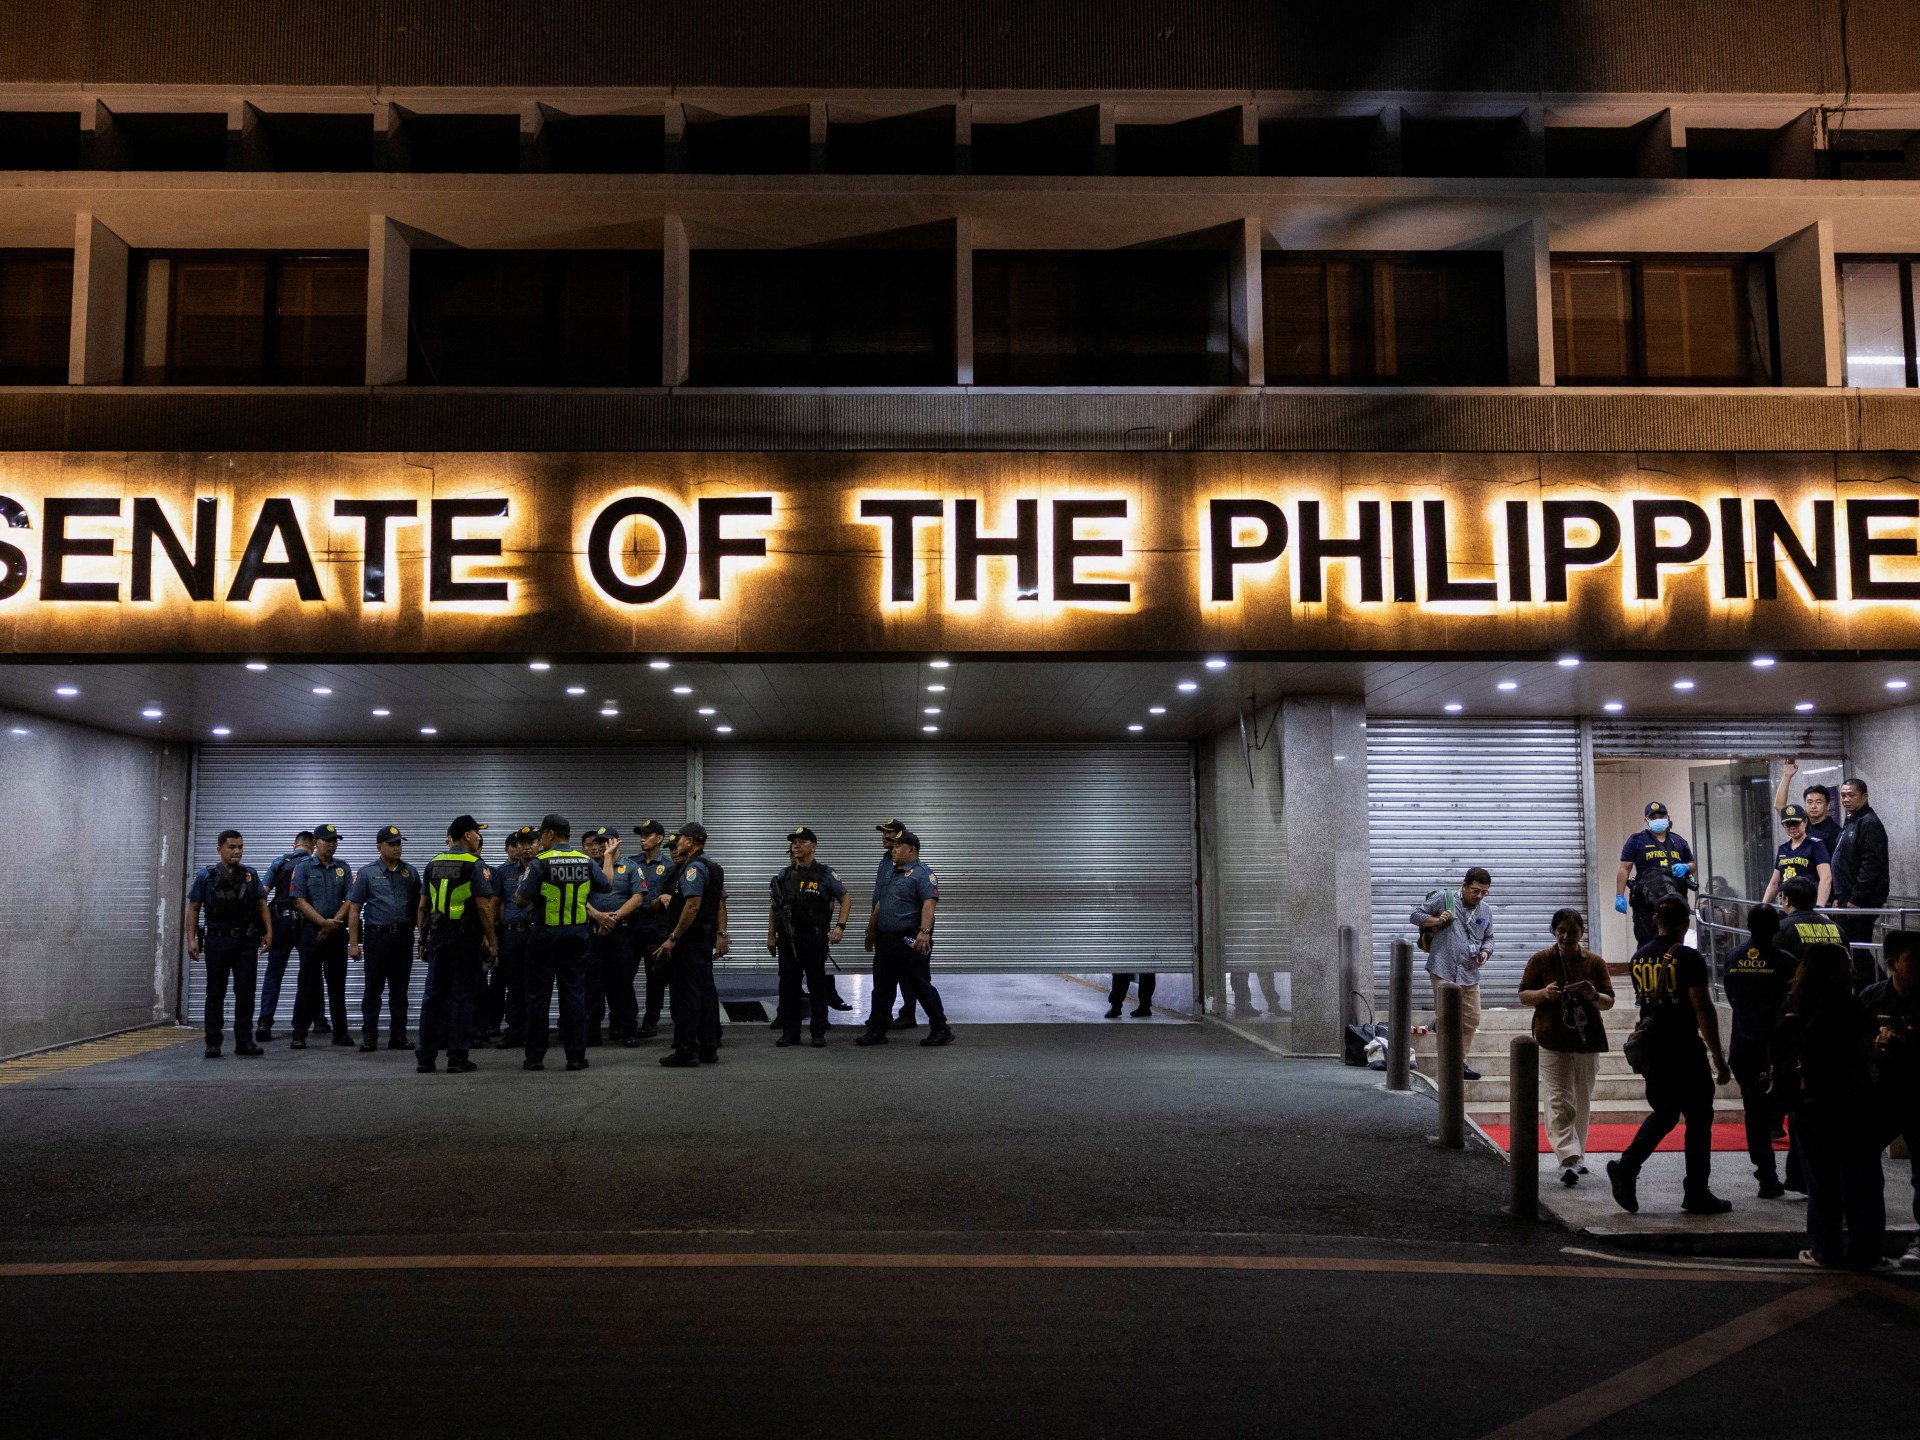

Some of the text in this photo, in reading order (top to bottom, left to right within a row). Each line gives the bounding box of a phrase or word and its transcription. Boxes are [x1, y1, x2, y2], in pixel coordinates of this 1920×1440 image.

[587, 495, 774, 603] OF
[860, 498, 1132, 602] THE
[1209, 498, 1920, 602] PHILIPPINE
[550, 866, 589, 881] POLICE
[1633, 957, 1678, 965] POLIE
[1737, 959, 1766, 968] SOCO
